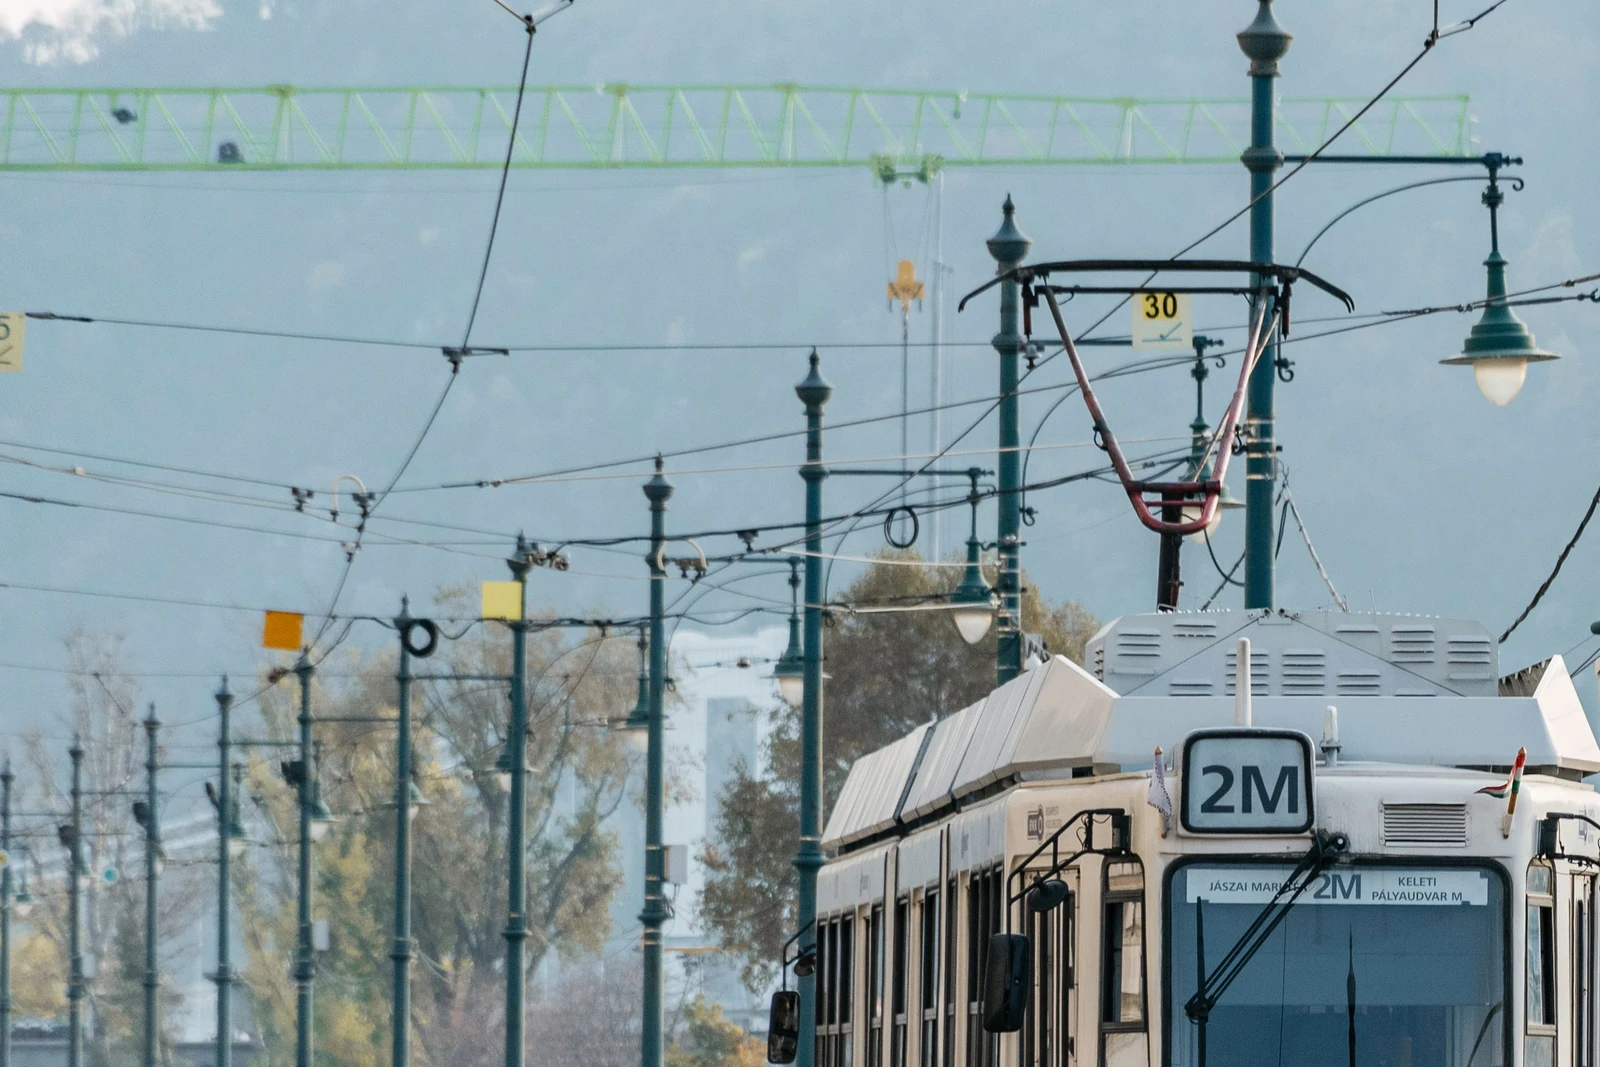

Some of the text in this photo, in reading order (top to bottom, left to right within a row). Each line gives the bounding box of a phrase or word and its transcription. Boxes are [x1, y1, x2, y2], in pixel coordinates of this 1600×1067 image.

[1145, 292, 1178, 319] 30
[1201, 765, 1298, 814] 2M
[1209, 880, 1248, 892] JÁSZAI
[1313, 873, 1362, 900] 2M
[1398, 876, 1437, 887] KELETI
[1371, 889, 1463, 901] PÁLYAUDVAR M
